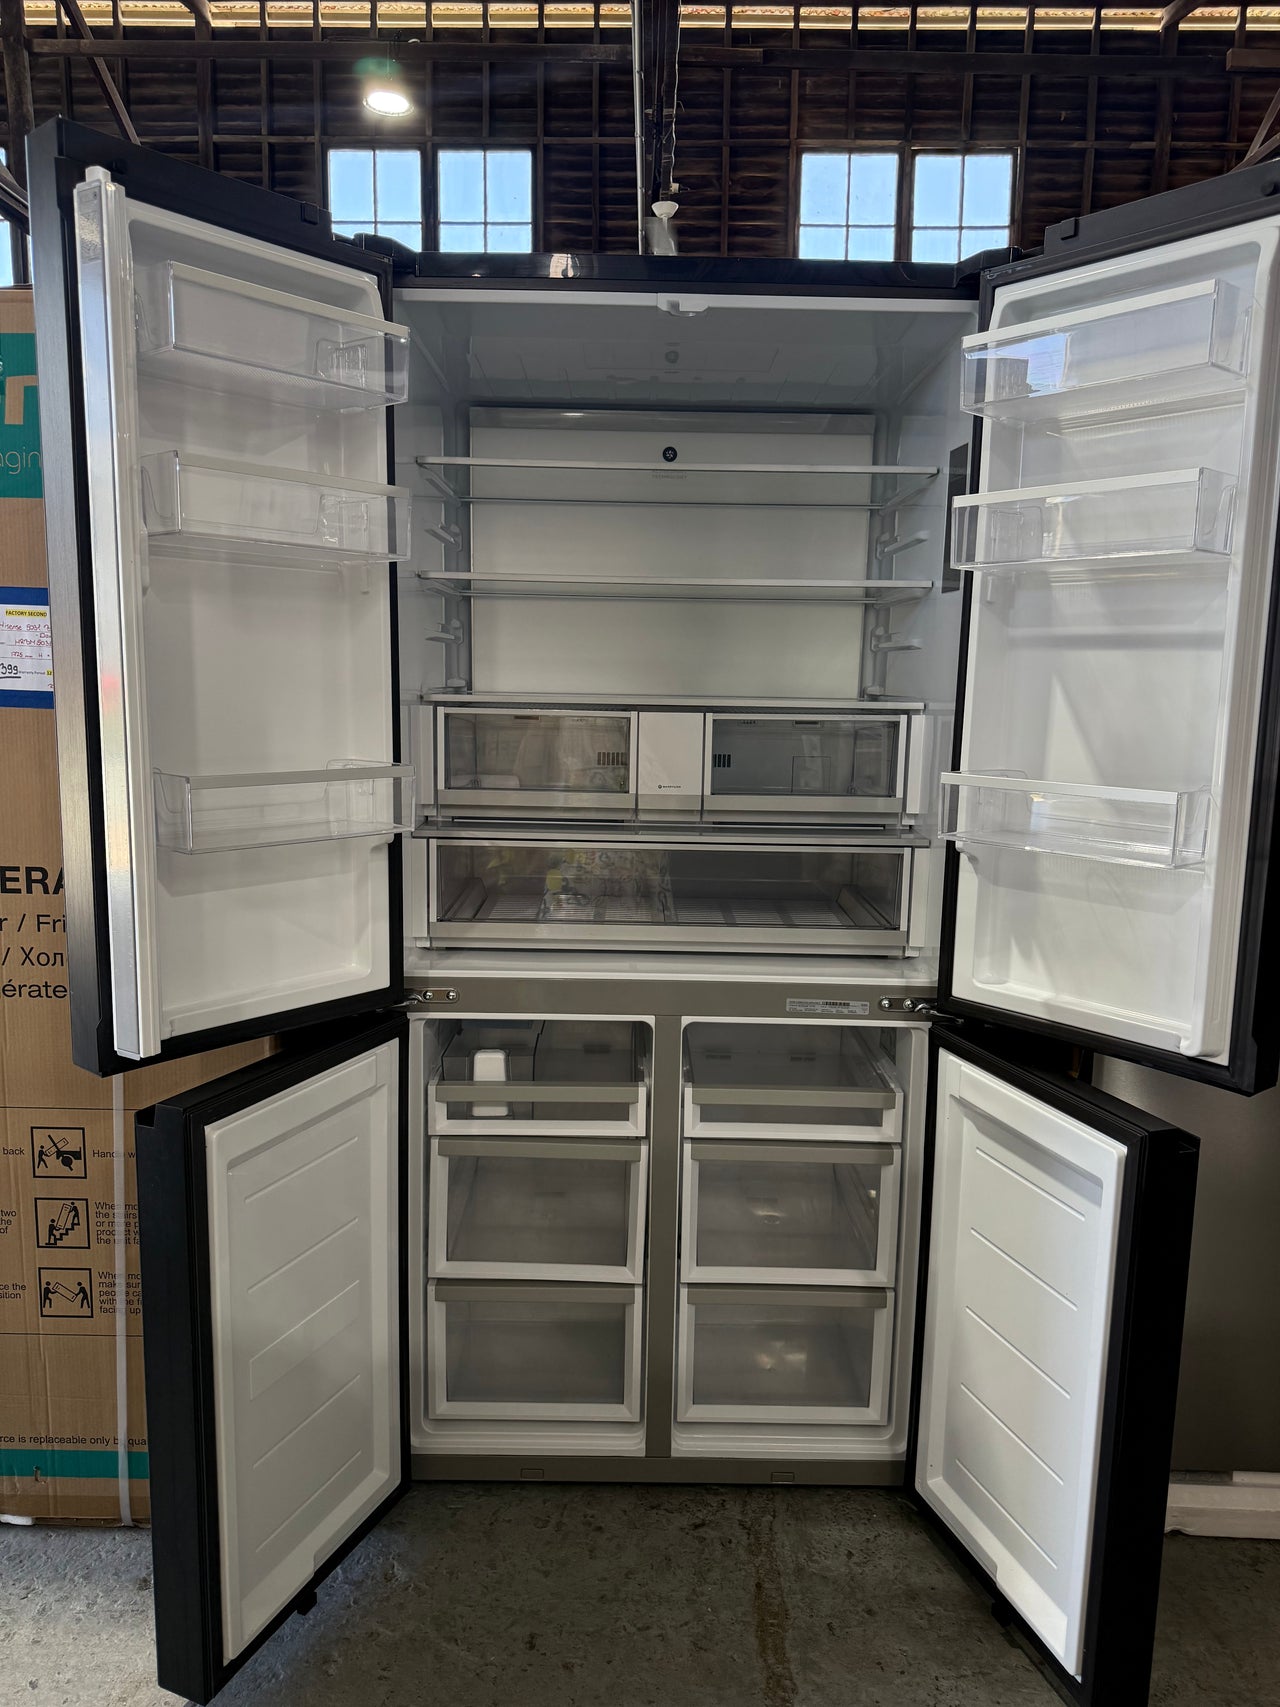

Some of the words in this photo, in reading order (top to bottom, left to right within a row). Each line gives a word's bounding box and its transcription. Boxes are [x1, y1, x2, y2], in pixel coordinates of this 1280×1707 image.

[17, 913, 26, 932] /
[37, 914, 65, 932] Fri
[20, 946, 64, 966] Хол
[2, 979, 68, 998] érate
[2, 1147, 25, 1155] back
[95, 1202, 121, 1210] Whe
[0, 1209, 17, 1217] two
[95, 1210, 110, 1218] the
[0, 1218, 12, 1226] he
[97, 1236, 111, 1244] the
[98, 1271, 121, 1280] Whe
[98, 1280, 121, 1288] mak
[129, 1308, 141, 1316] up
[18, 1435, 26, 1443] is
[29, 1435, 87, 1446] replaceable
[90, 1436, 110, 1446] only
